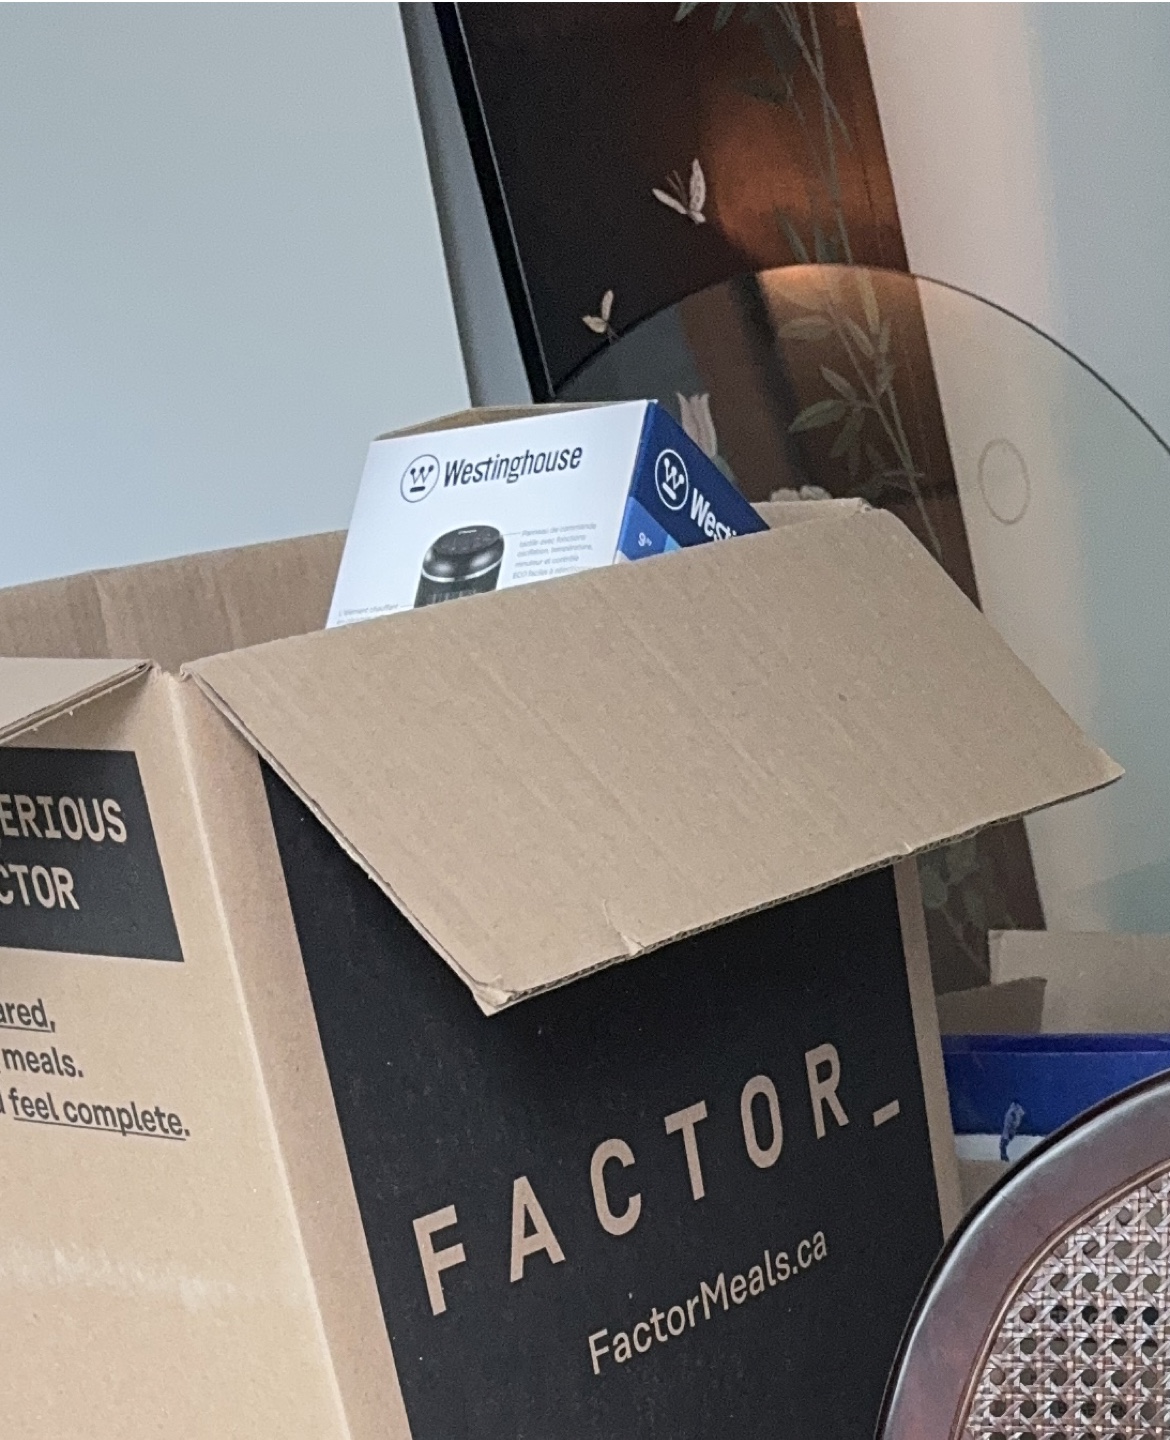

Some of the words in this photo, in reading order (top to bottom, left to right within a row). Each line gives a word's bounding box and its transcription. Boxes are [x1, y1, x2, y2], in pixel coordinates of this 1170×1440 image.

[444, 446, 583, 487] Westinghouse
[690, 488, 737, 542] West
[0, 793, 127, 843] ERIOUS
[1, 1046, 84, 1078] meals.
[9, 1086, 60, 1121] feel
[63, 1101, 190, 1137] complete.
[588, 1230, 828, 1375] FactorMeals.ca
